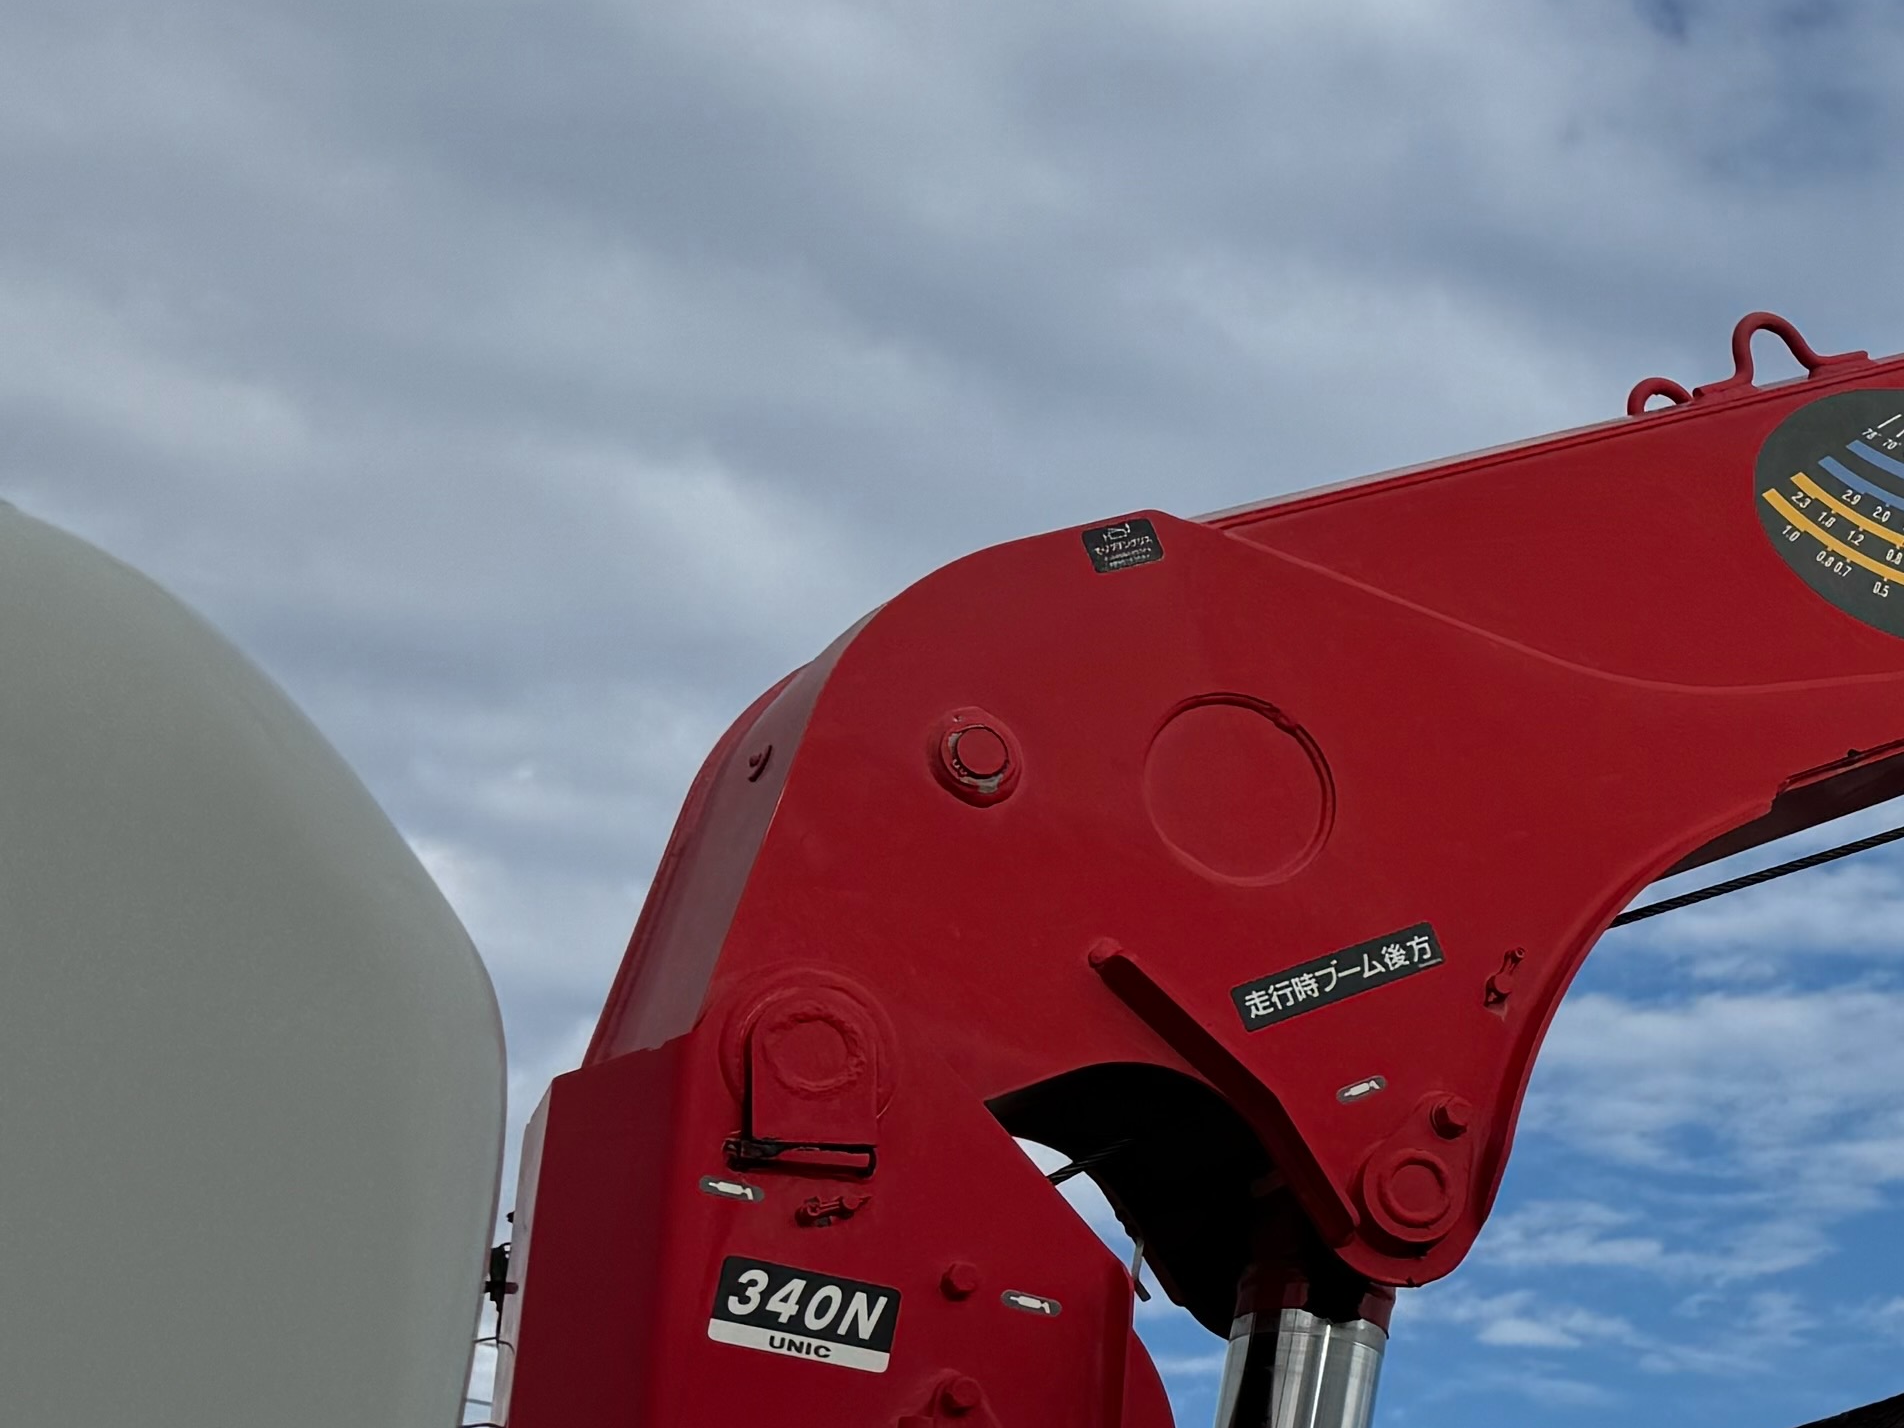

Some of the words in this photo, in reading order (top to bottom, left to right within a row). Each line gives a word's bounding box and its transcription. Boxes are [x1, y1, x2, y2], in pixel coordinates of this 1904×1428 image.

[1790, 491, 1812, 509] 2.3
[1817, 511, 1837, 528] 1.8
[1847, 530, 1865, 546] 1.2
[1885, 549, 1904, 566] 0.8
[1841, 489, 1862, 505] 2.9
[1872, 506, 1891, 523] 2.0
[1782, 524, 1801, 542] 1.0
[1816, 550, 1835, 567] 0.8
[1833, 561, 1853, 577] 0.7
[1872, 581, 1890, 598] 0.5
[1244, 935, 1433, 1019] 走行時ブーム後方
[727, 1269, 888, 1340] 340N
[768, 1335, 832, 1359] UNIC
